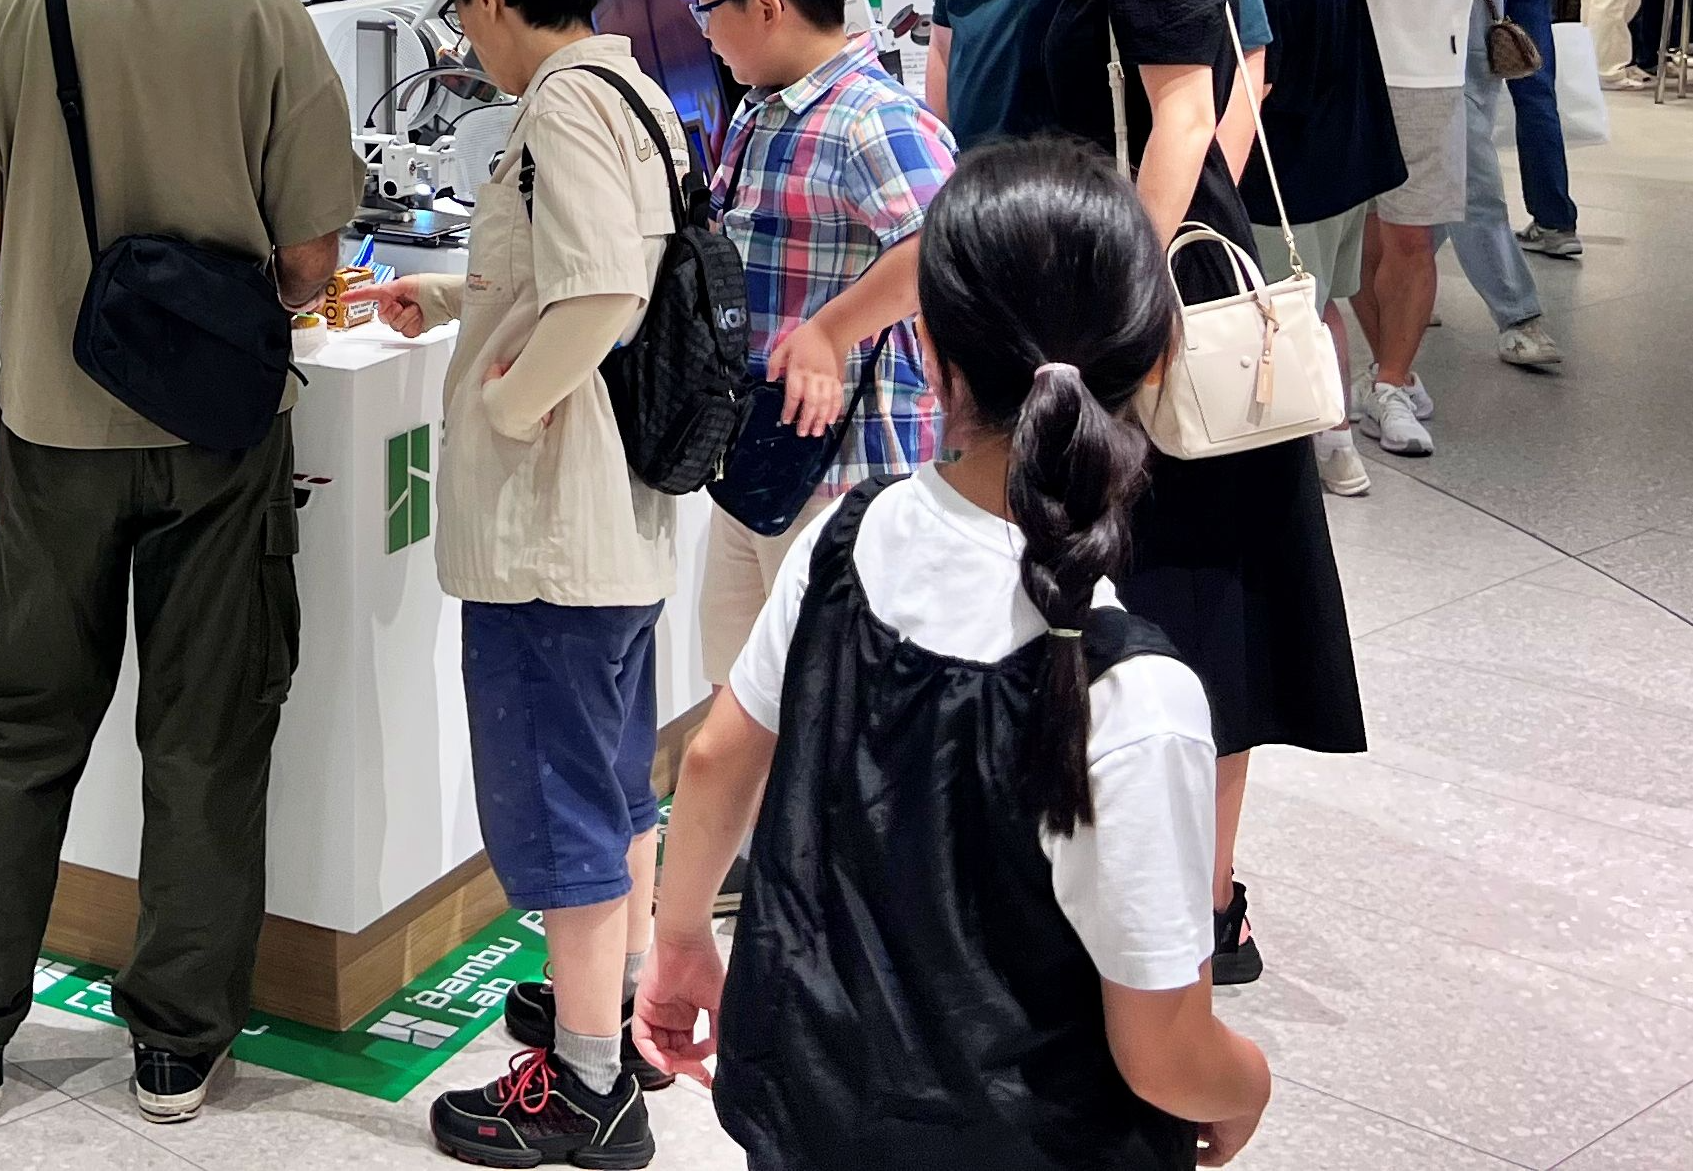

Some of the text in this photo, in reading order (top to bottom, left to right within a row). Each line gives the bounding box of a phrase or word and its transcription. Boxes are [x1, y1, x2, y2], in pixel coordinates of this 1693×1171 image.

[404, 936, 523, 1010] Bambu
[64, 990, 115, 1017] La
[447, 977, 517, 1019] Lab
